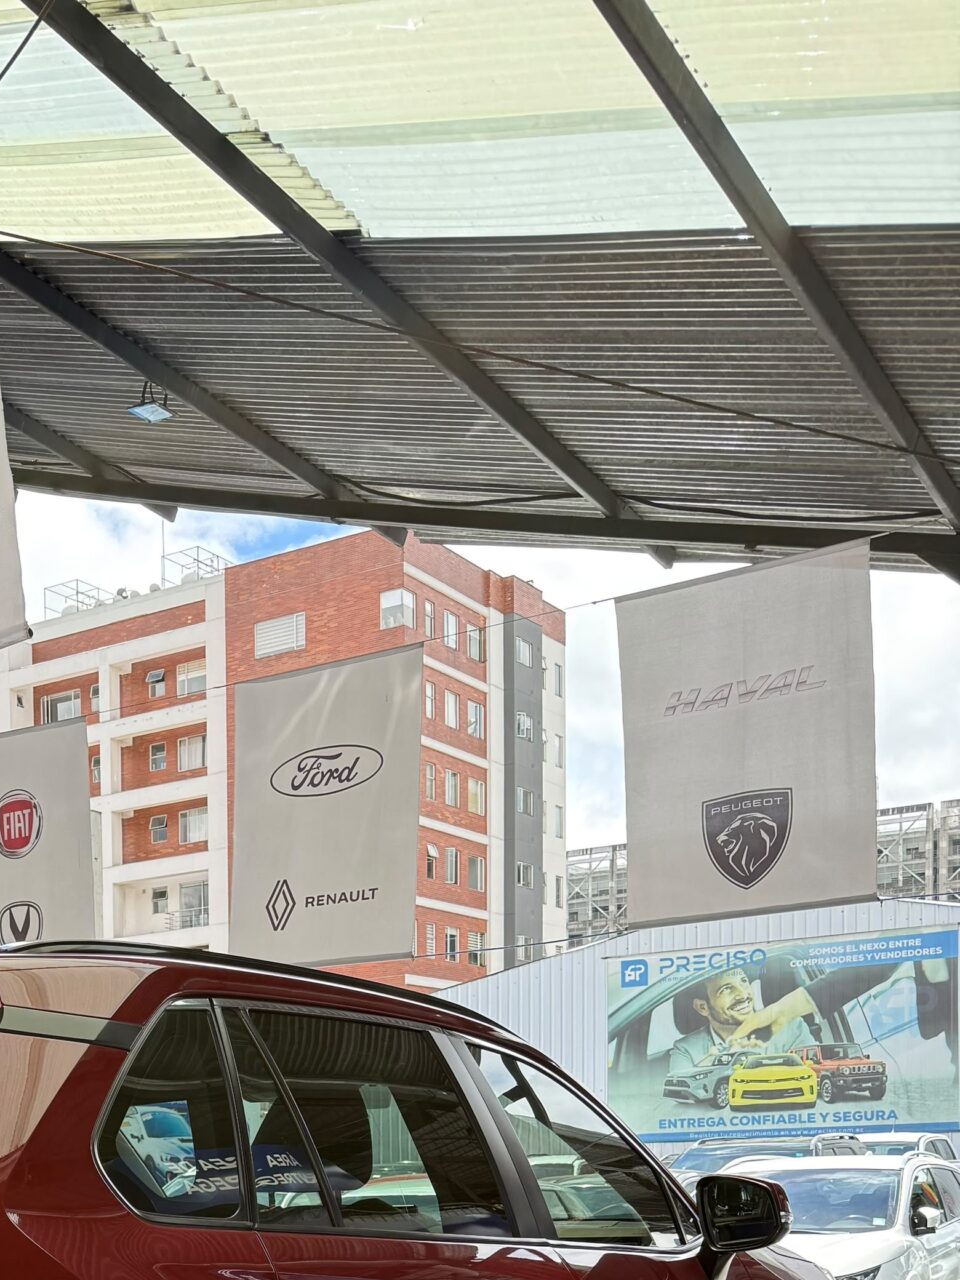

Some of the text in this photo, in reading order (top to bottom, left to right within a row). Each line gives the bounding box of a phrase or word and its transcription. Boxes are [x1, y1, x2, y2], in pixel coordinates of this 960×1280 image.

[663, 665, 827, 716] HAVAL
[291, 752, 360, 791] Ford
[711, 797, 784, 816] PEUGEOT
[2, 808, 31, 841] FIAT
[305, 887, 379, 908] RENAULT
[790, 946, 943, 967] COMPRADORES Y VENDEDORES
[808, 937, 922, 956] SOMOS EL NEXO ENTRE
[658, 948, 767, 975] PRECISO
[658, 1109, 899, 1130] ENTREGA CONFIABLE Y SEGURA
